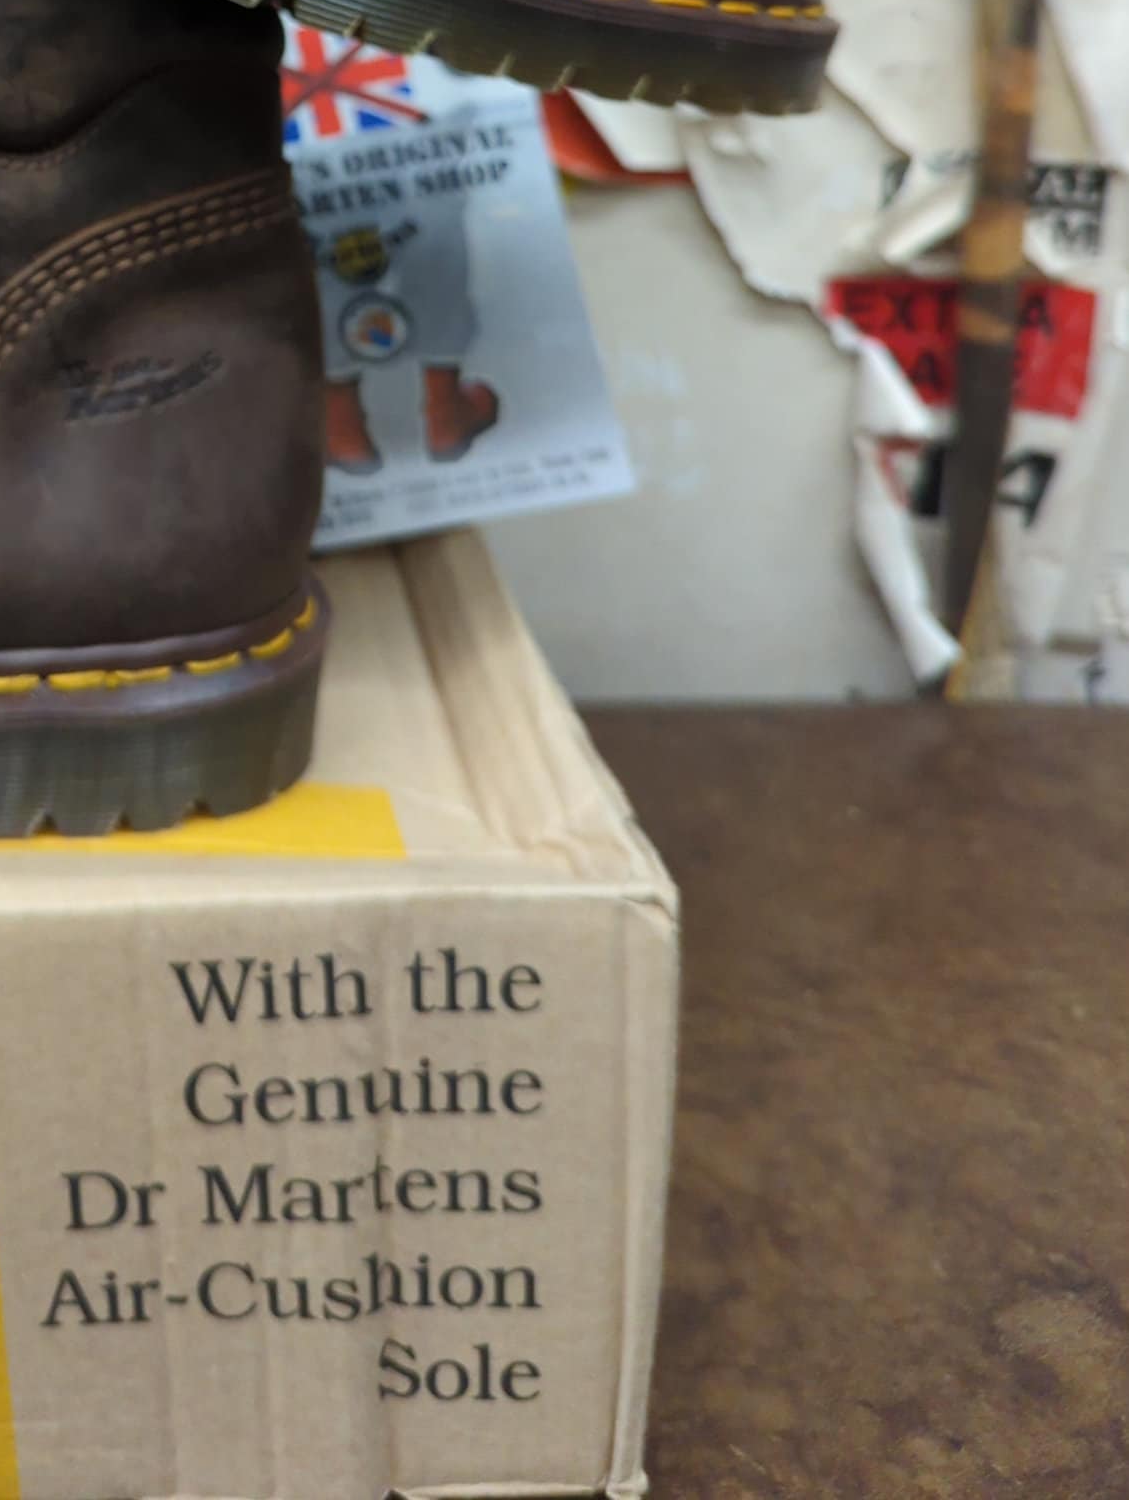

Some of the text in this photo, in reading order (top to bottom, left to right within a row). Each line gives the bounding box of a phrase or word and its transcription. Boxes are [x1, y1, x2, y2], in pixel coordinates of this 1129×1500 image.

[342, 125, 514, 177] ORIGINAL
[300, 159, 511, 218] ARTEN SHOP
[169, 947, 544, 1025] With the
[182, 1056, 546, 1126] Genuine
[62, 1154, 544, 1232] Dr Martens
[40, 1254, 543, 1329] Air-Cushion
[377, 1338, 543, 1403] Sole
